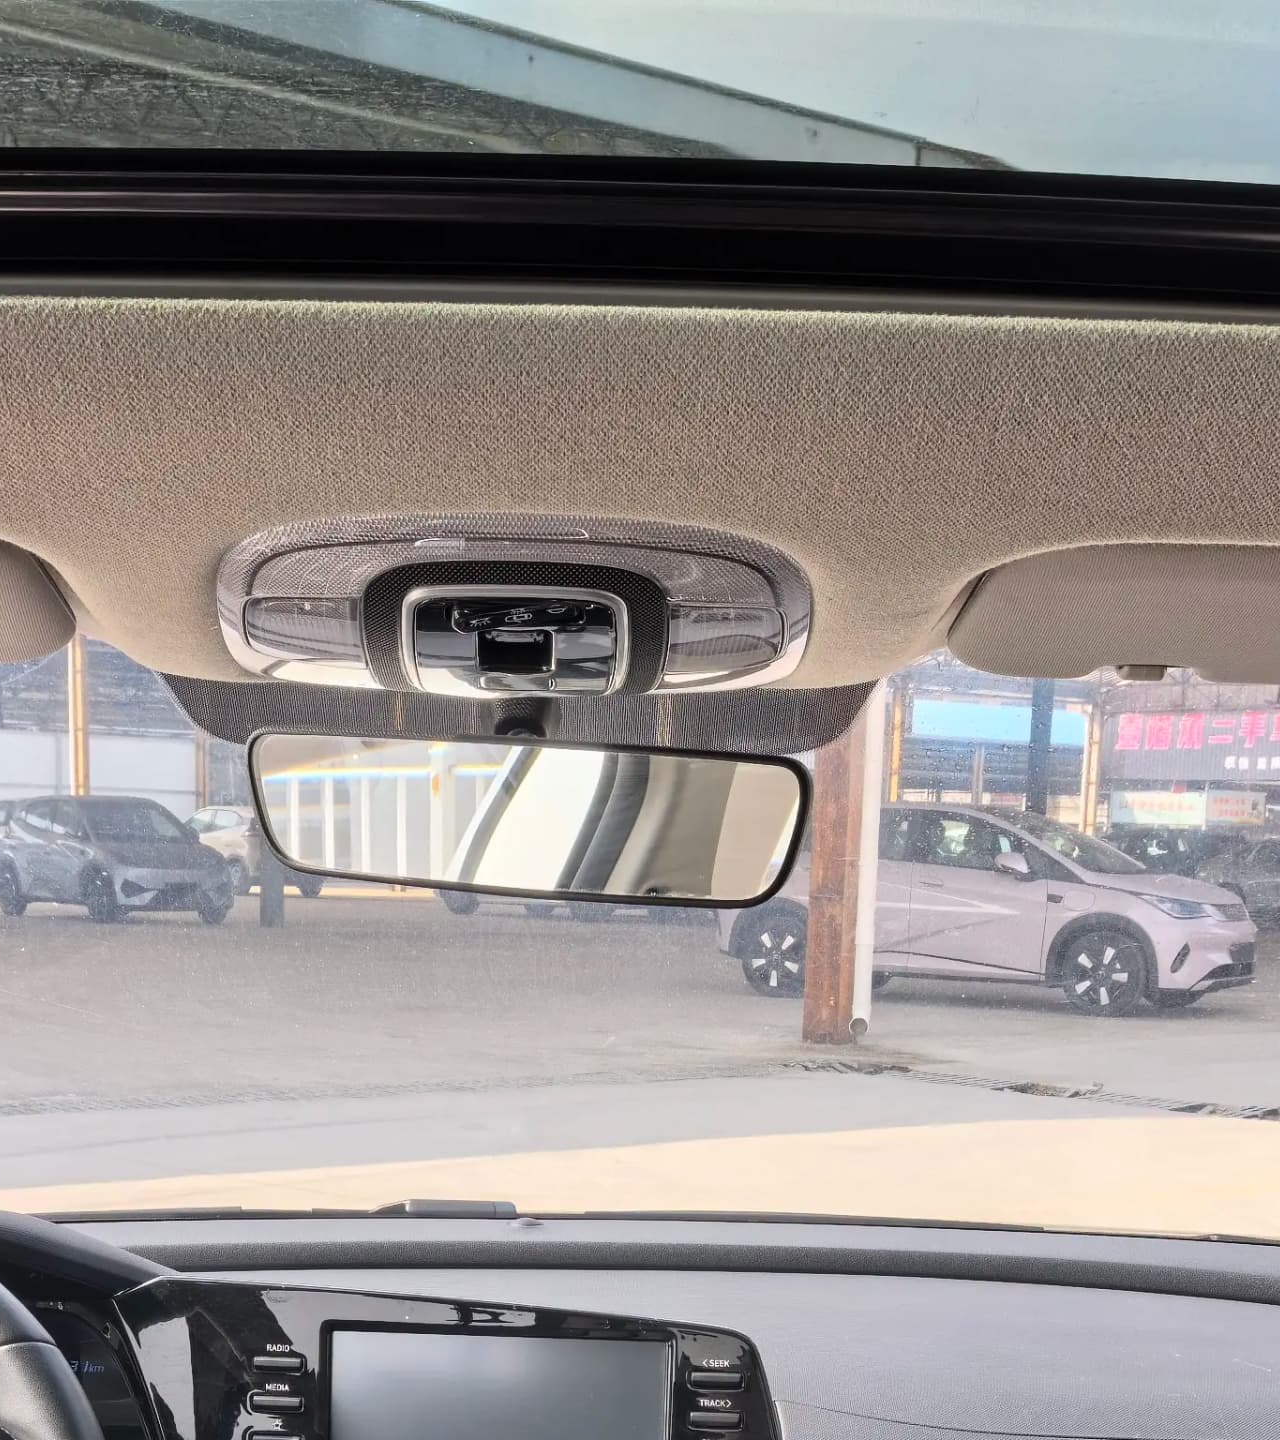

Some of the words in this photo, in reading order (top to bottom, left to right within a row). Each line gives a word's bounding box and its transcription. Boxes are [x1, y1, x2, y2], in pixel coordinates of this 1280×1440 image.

[266, 1343, 290, 1352] RADIO
[709, 1359, 730, 1367] SEEK
[265, 1383, 290, 1392] MEDIA
[700, 1399, 726, 1408] TRACK
